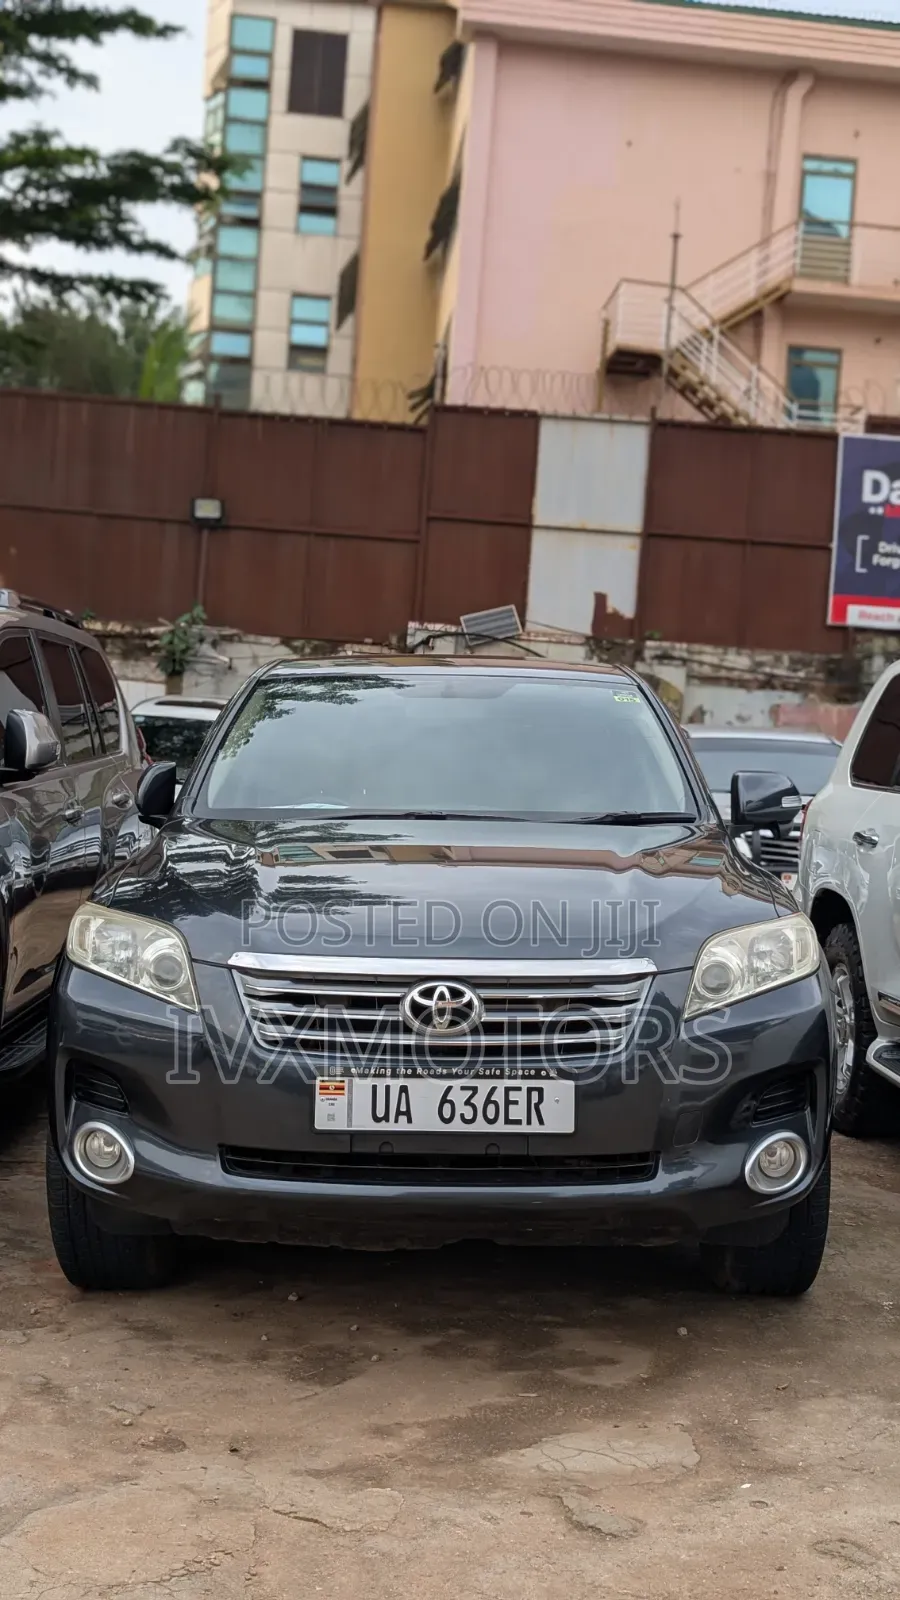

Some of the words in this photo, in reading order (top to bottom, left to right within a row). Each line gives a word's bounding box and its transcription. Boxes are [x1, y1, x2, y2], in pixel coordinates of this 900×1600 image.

[356, 1066, 392, 1076] Making
[396, 1066, 412, 1075] the
[416, 1067, 447, 1075] Roads
[452, 1067, 474, 1075] Your
[478, 1067, 501, 1075] Safe
[505, 1067, 536, 1076] Space
[371, 1084, 413, 1124] UA
[437, 1085, 545, 1126] 636ER
